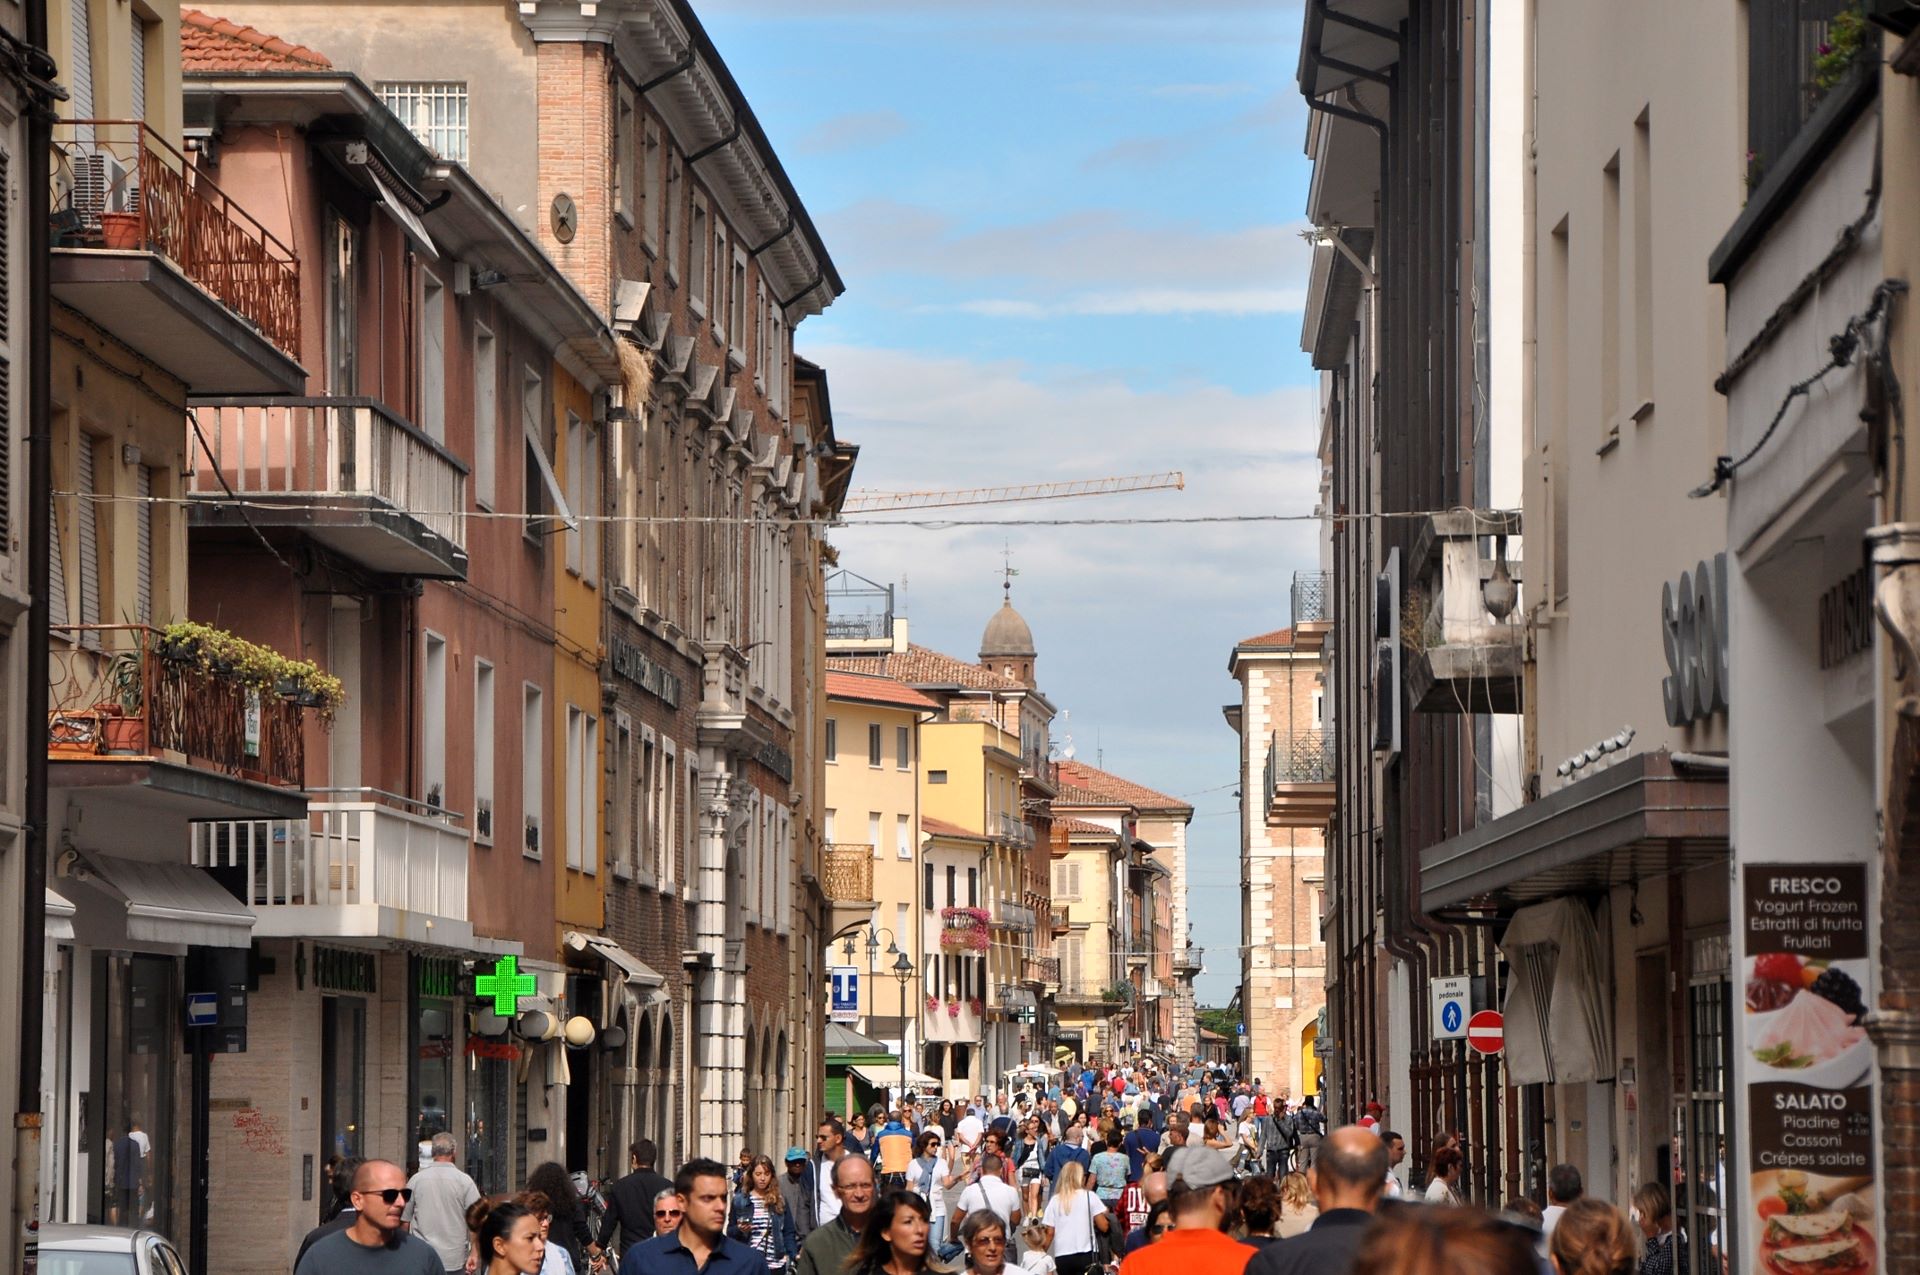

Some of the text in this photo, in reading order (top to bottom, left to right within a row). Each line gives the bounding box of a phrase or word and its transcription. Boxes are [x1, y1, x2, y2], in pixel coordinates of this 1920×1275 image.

[1770, 877, 1841, 894] FRESCO
[1755, 899, 1857, 915] Yogurt Frozen
[1751, 917, 1862, 930] Estratti di frutta
[1783, 935, 1831, 949] Frullati
[1438, 990, 1464, 1000] pedonale
[1775, 1093, 1847, 1110] SALATO
[1783, 1115, 1840, 1129] Piadine
[1783, 1133, 1842, 1147] Cassoni
[1819, 1152, 1866, 1165] salate
